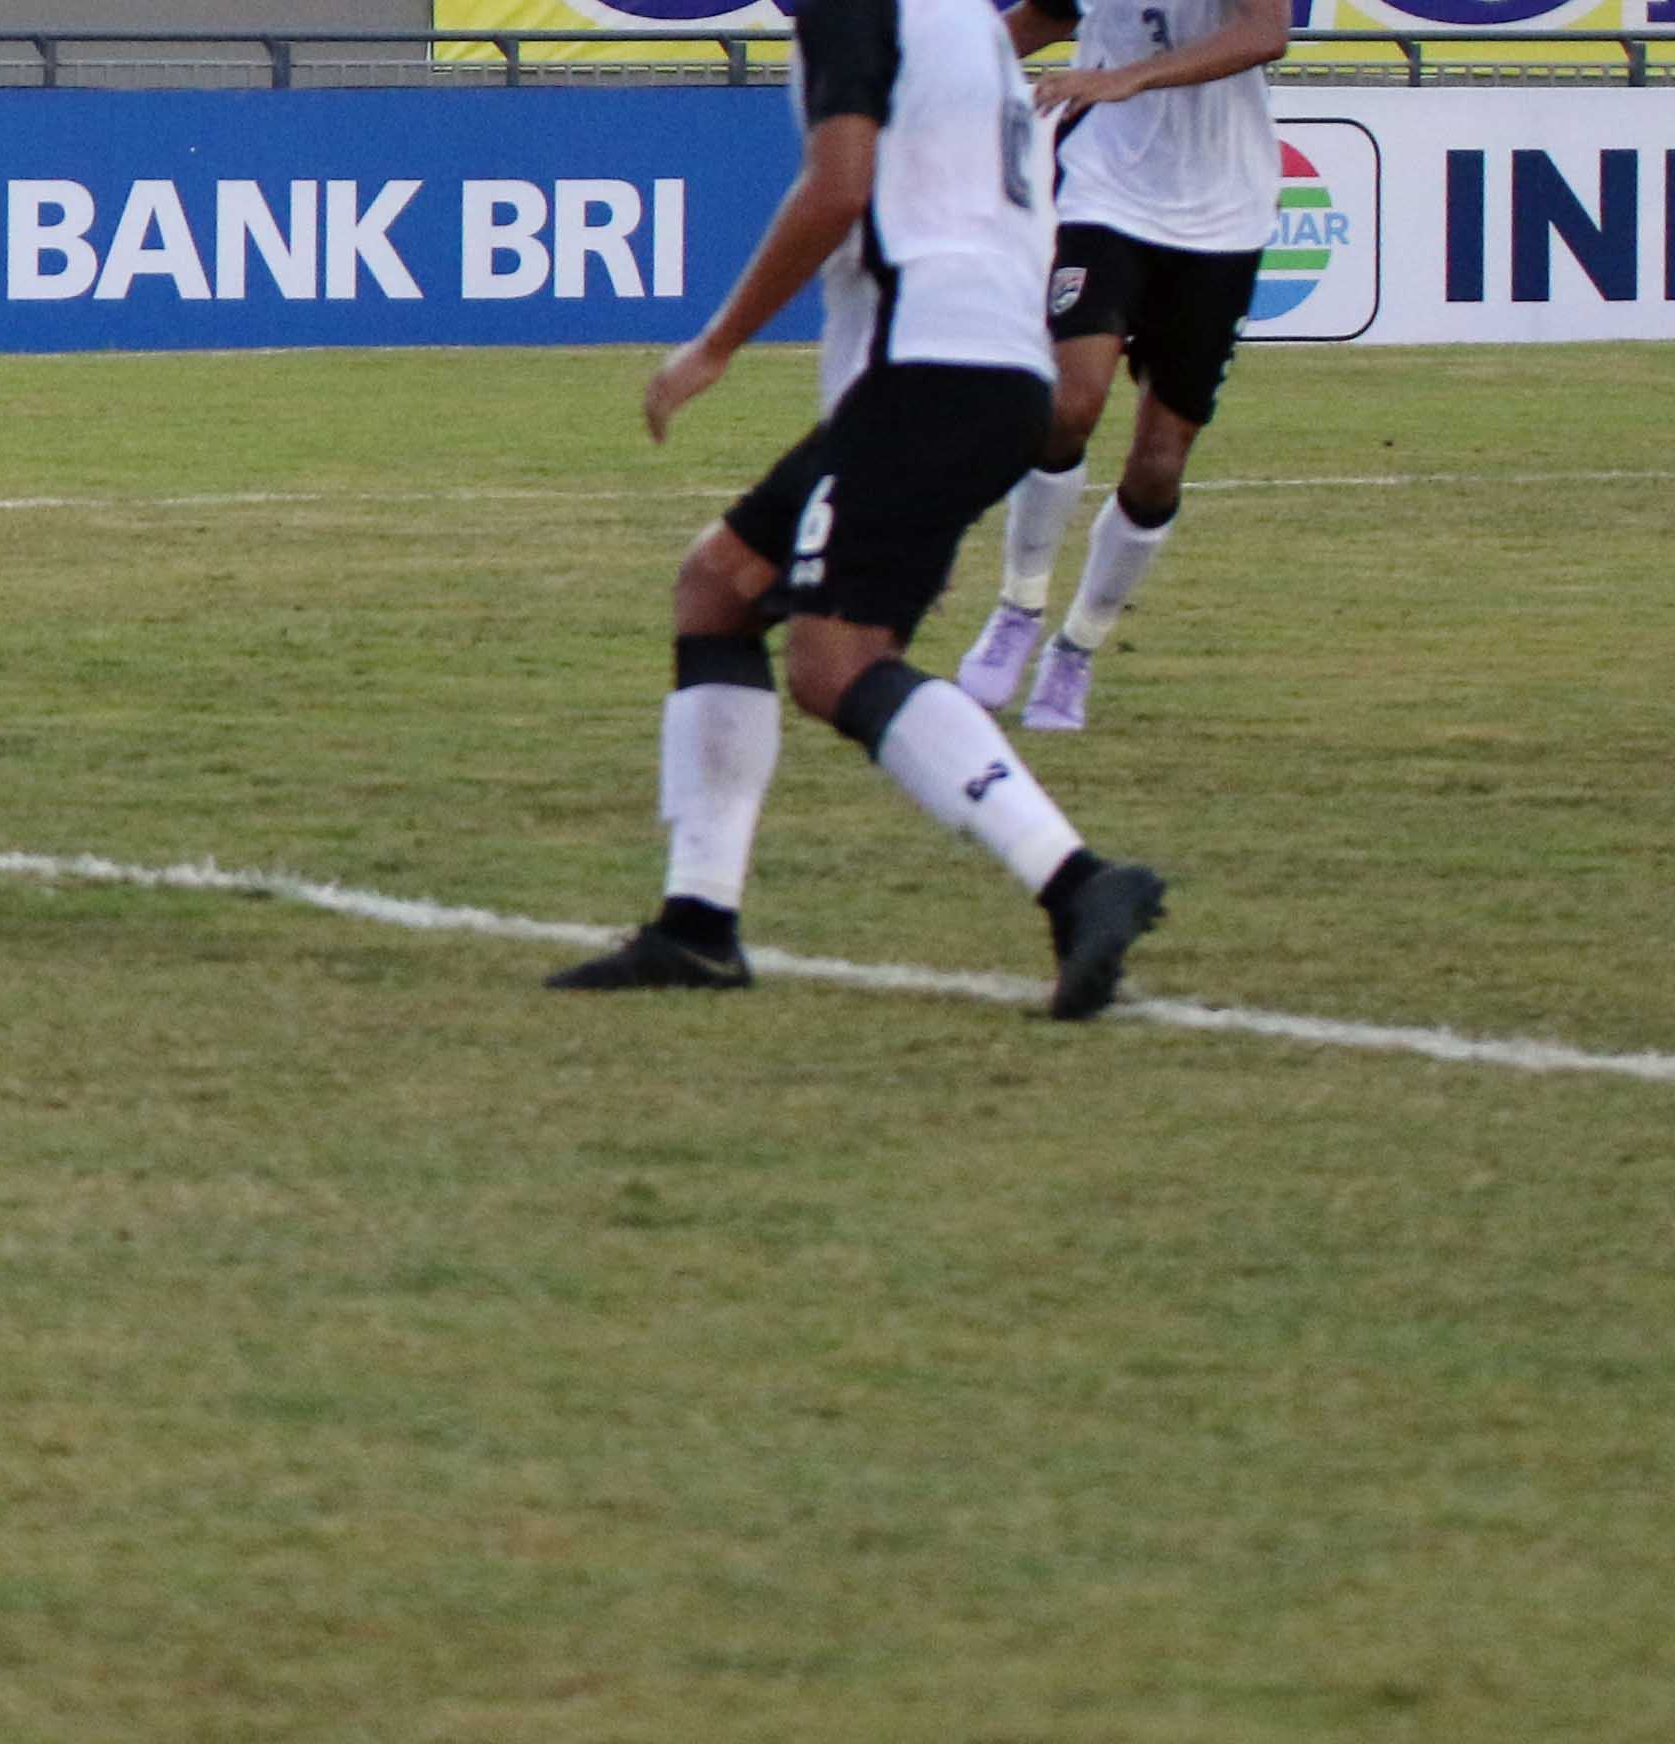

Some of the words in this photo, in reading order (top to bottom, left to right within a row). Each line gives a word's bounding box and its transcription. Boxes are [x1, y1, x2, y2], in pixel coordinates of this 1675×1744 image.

[7, 179, 423, 301] BANK
[462, 178, 685, 299] BRI
[1445, 148, 1675, 302] IN
[795, 474, 836, 555] 6
